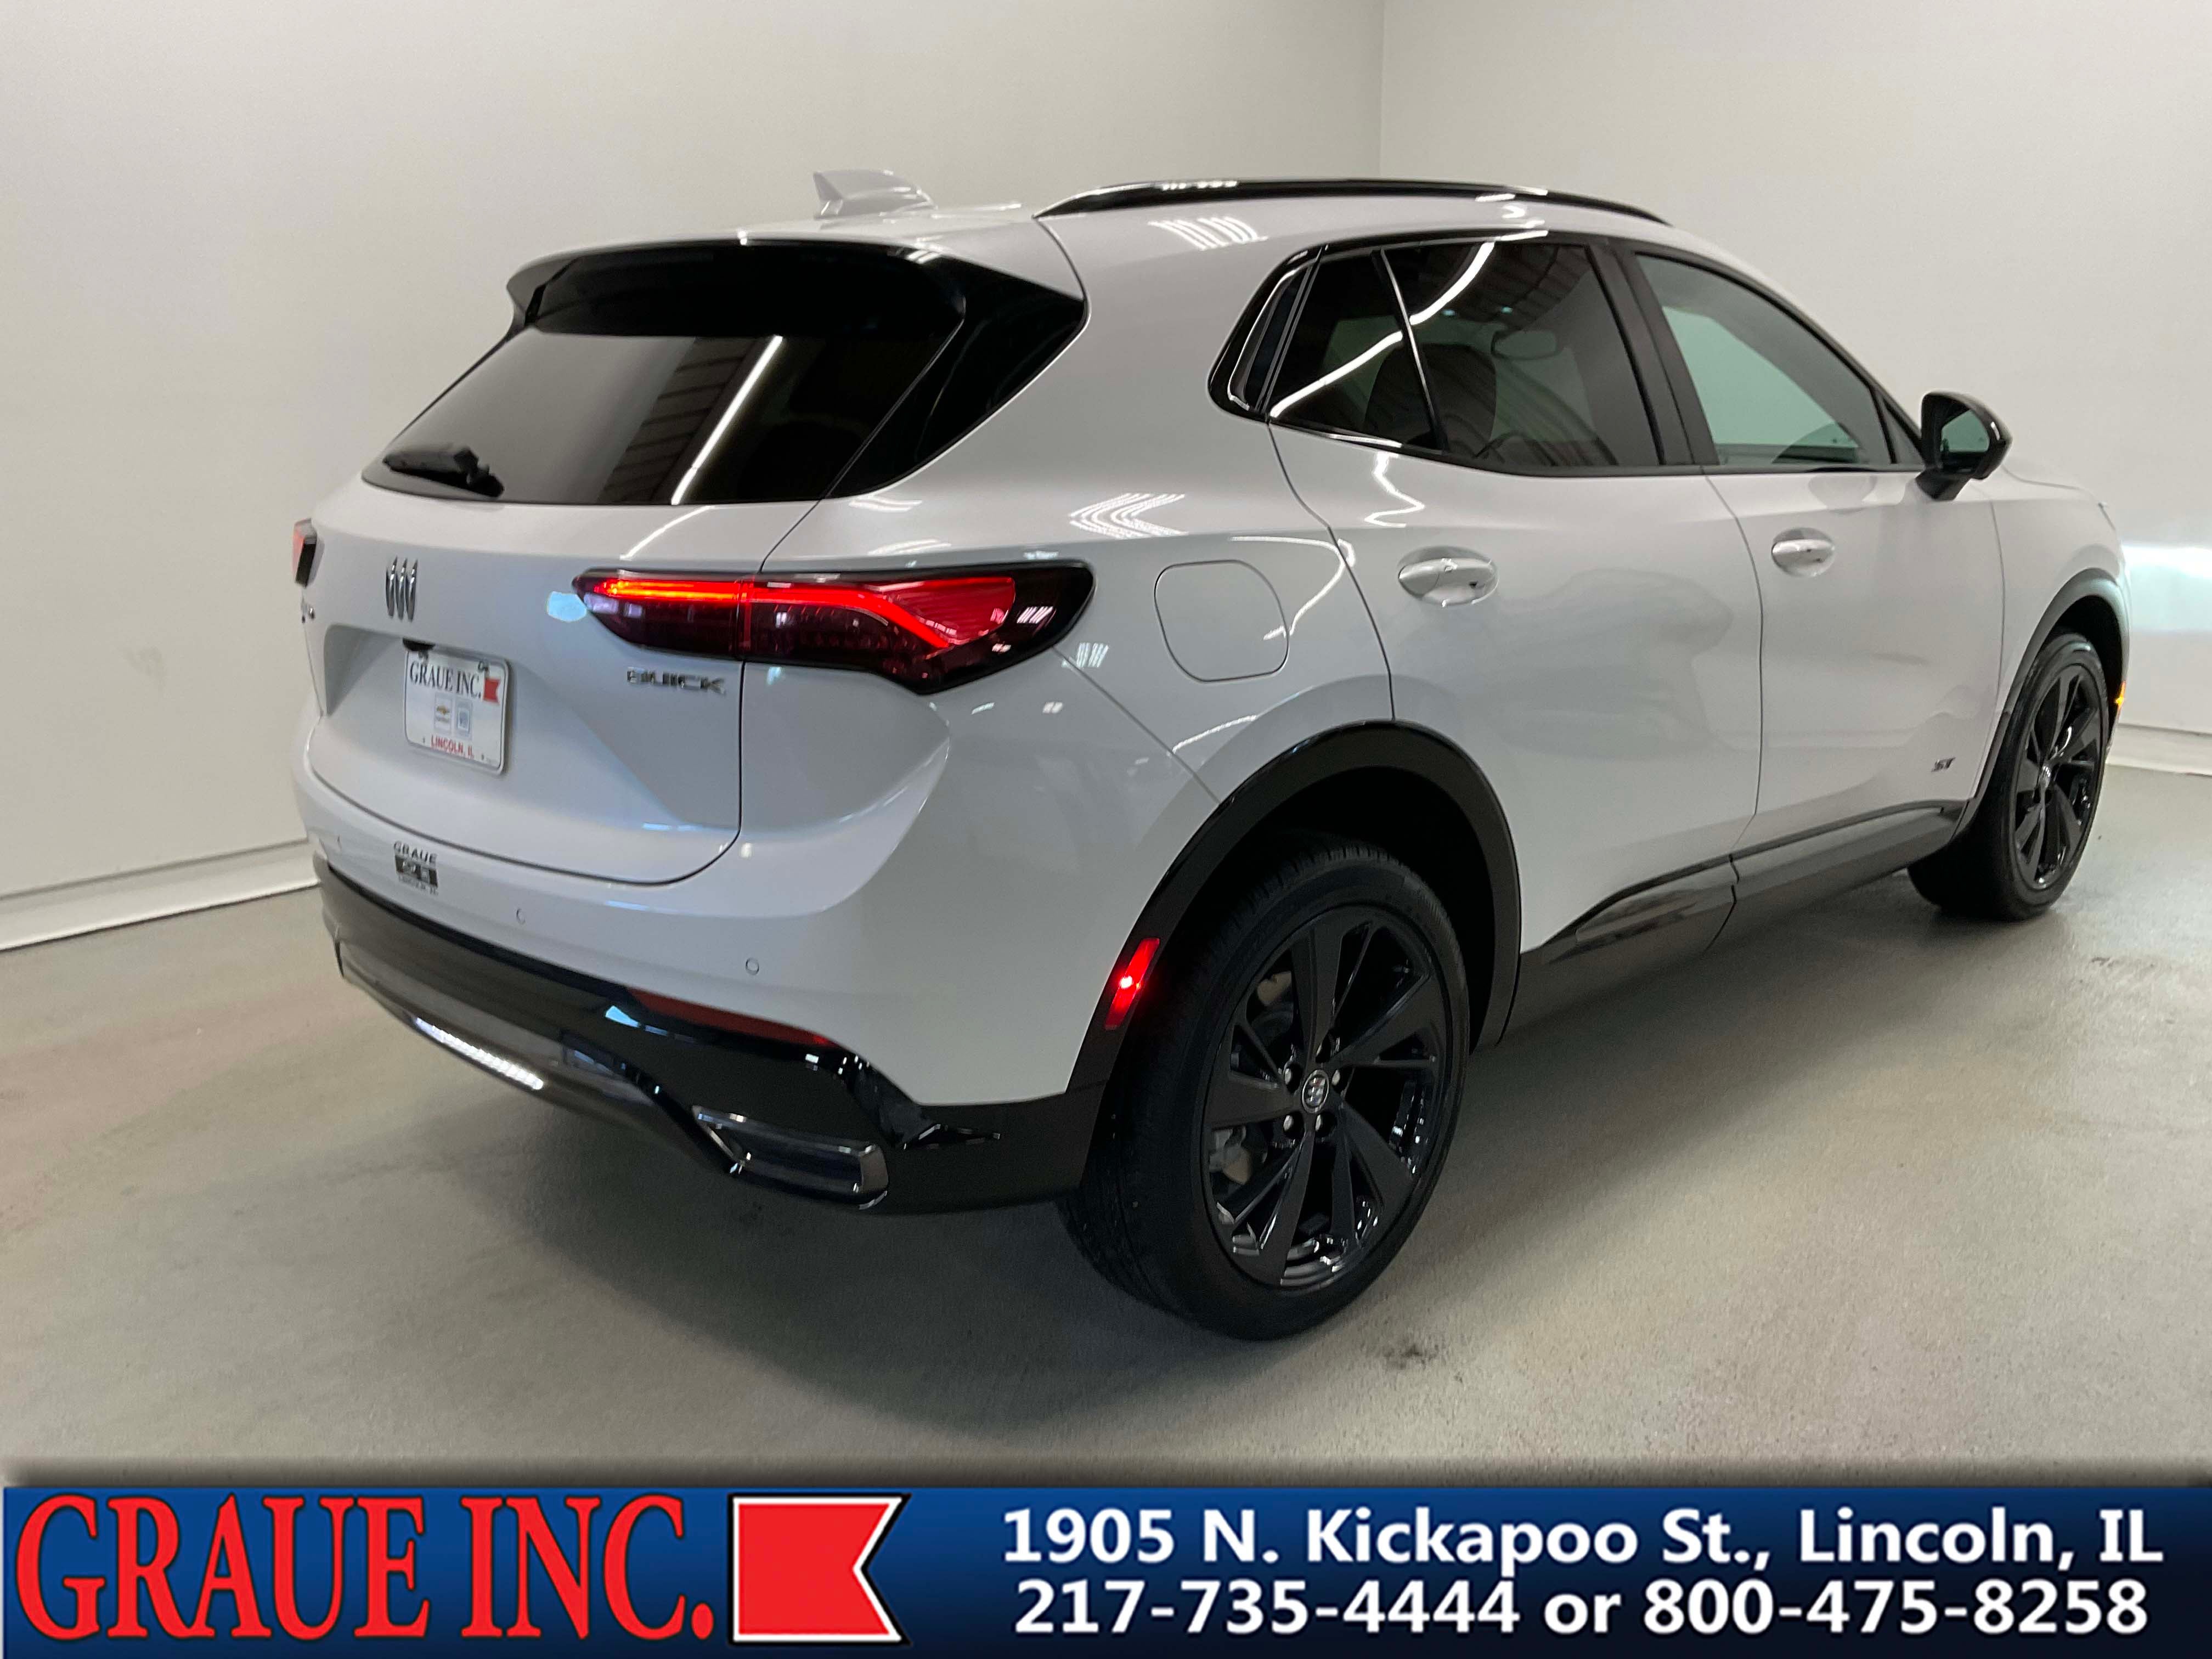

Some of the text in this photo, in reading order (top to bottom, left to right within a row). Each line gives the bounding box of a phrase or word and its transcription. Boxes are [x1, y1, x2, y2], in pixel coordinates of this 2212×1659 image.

[410, 661, 481, 698] GRAUE INC.
[627, 667, 726, 696] BUICK
[393, 840, 438, 864] GRAUE
